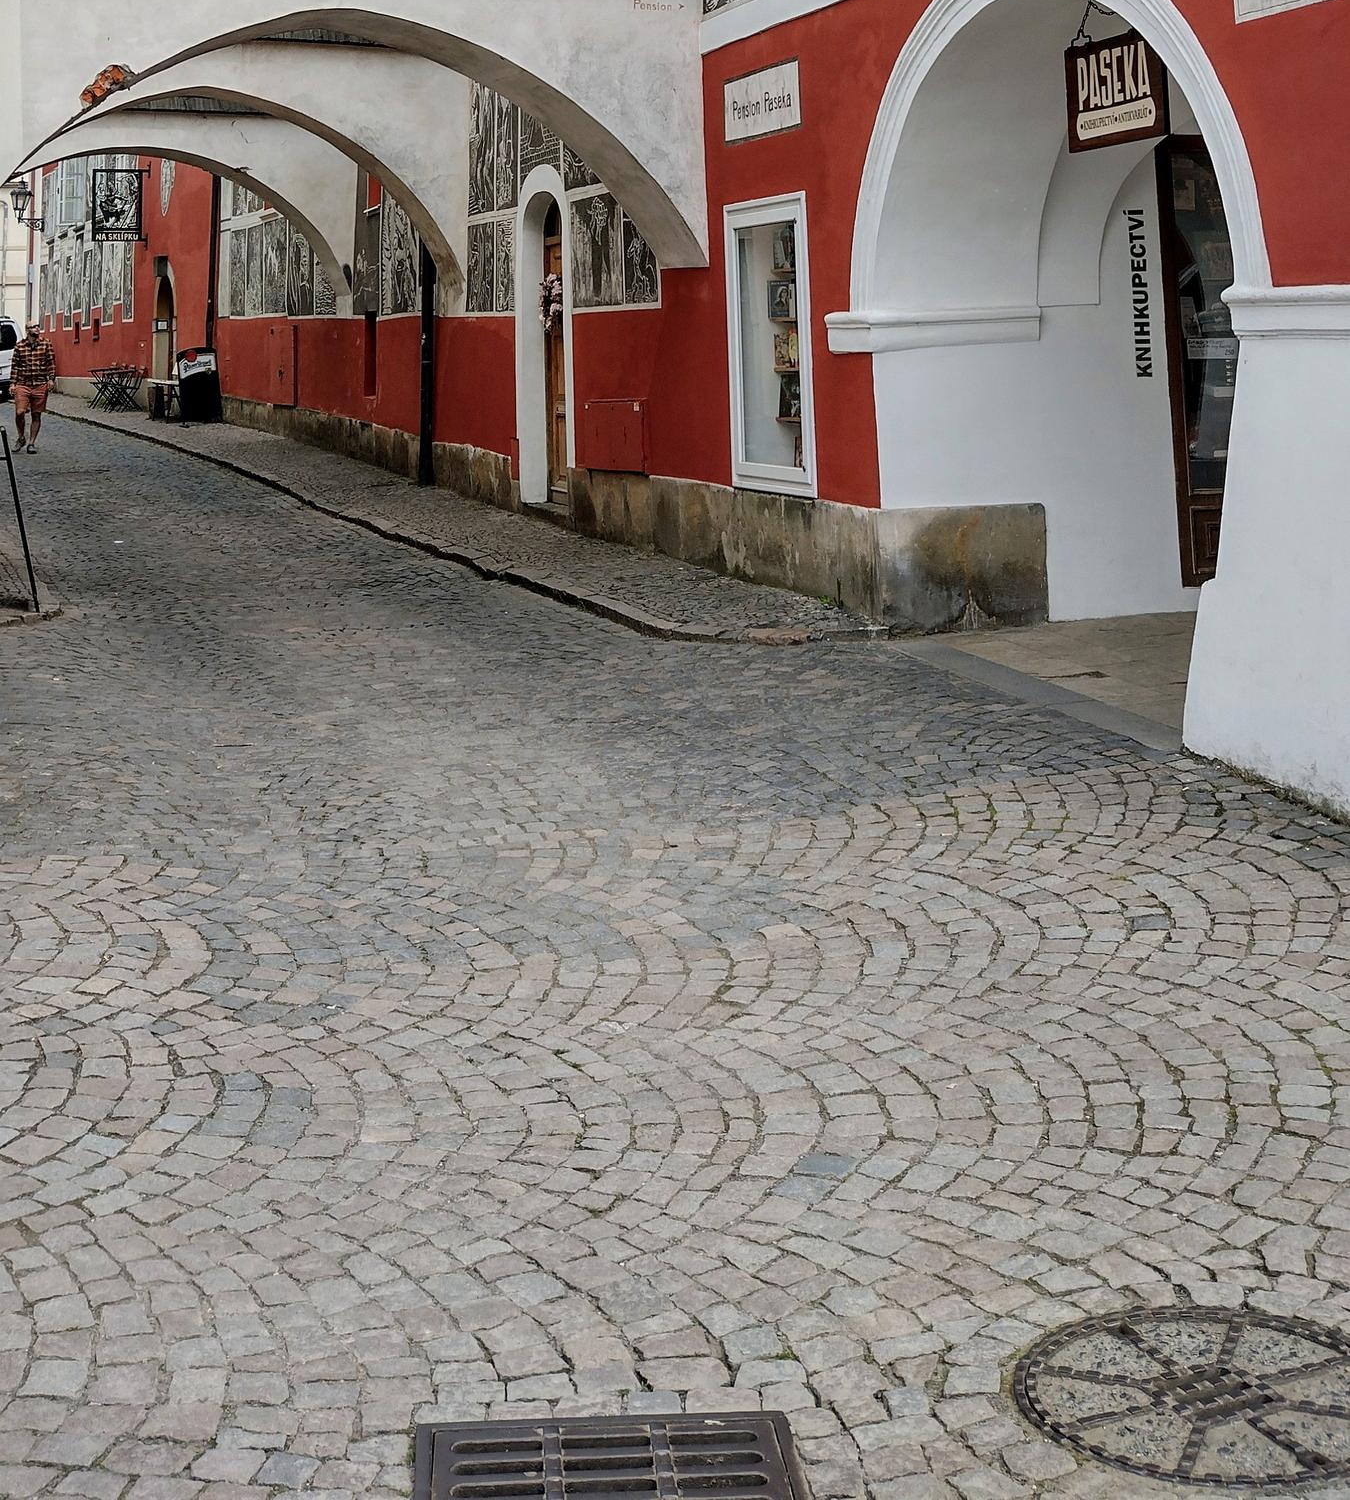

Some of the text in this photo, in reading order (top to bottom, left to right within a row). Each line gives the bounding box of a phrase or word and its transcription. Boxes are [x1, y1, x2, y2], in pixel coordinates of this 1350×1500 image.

[1076, 40, 1151, 111] PASEKA
[732, 91, 792, 121] Pension Paseka
[95, 233, 106, 241] NA
[1122, 209, 1153, 378] KNIHKUPECTVÍ
